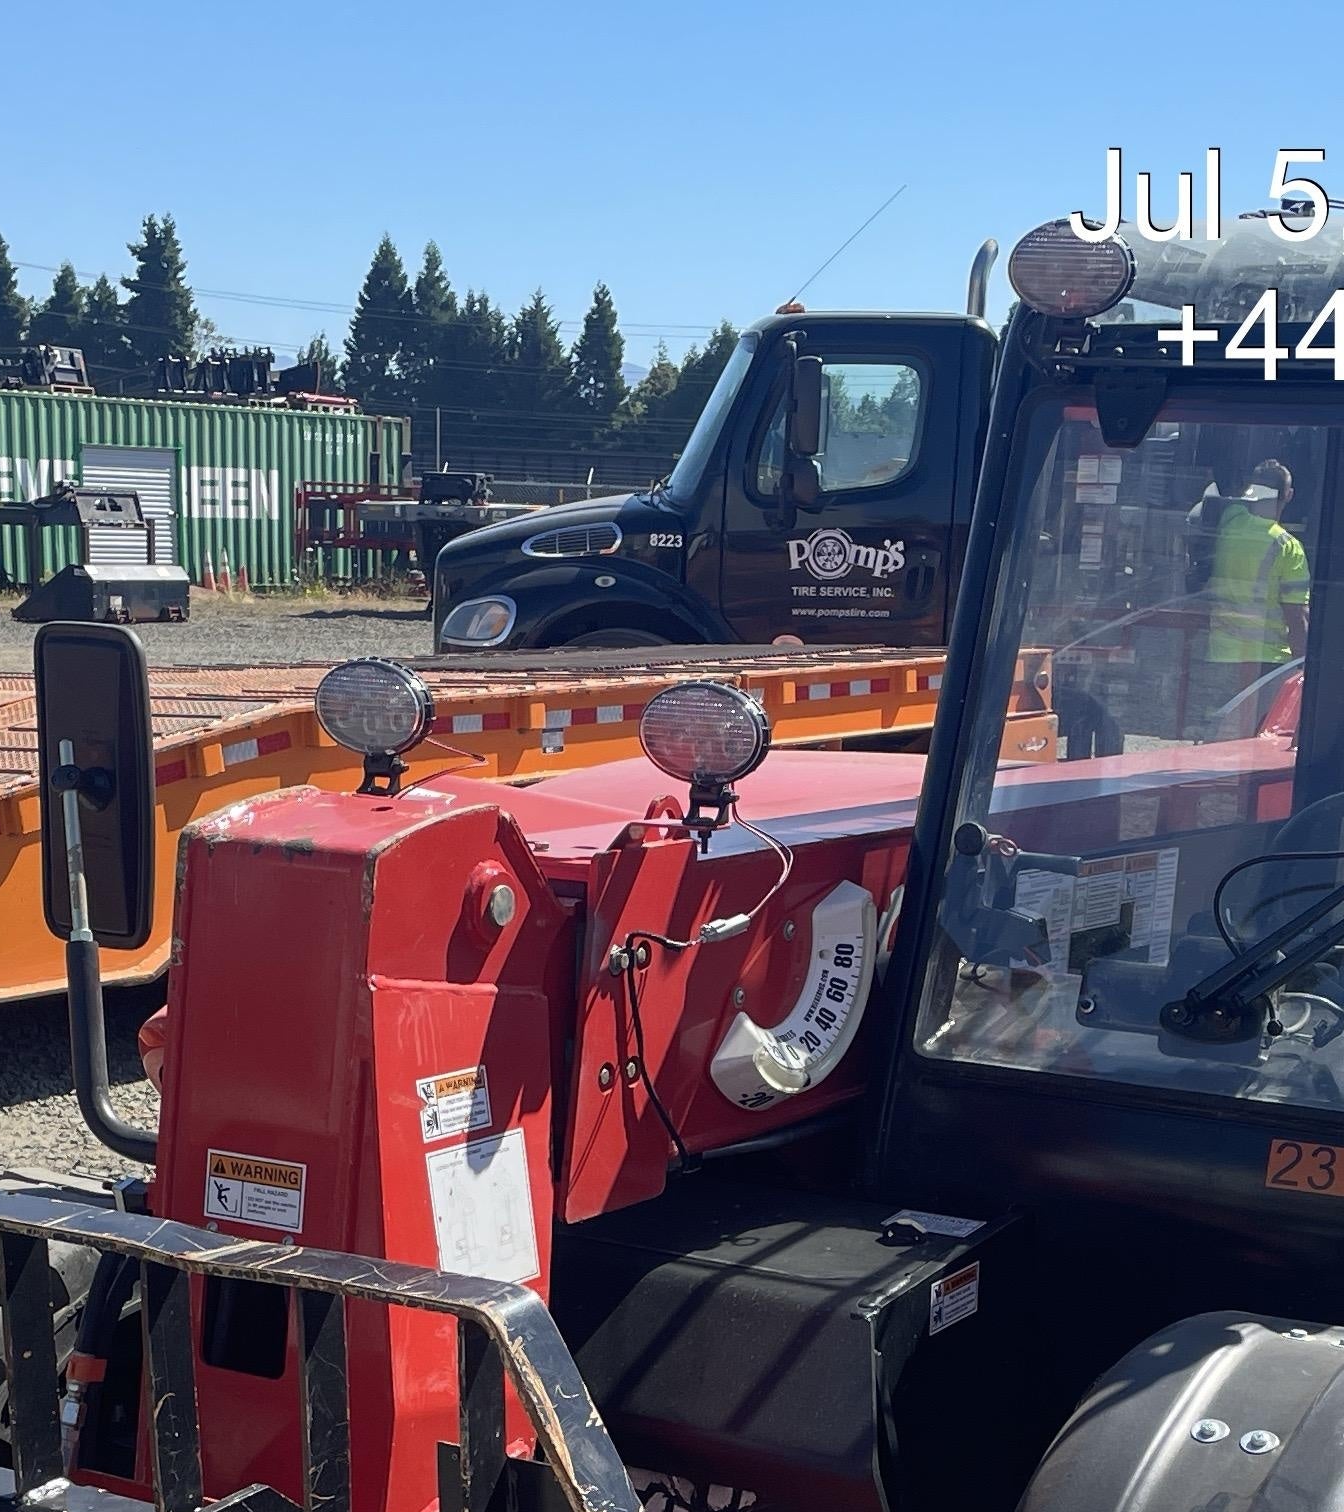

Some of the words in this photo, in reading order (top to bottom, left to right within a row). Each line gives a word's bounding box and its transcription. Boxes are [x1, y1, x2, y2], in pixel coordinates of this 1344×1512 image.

[649, 533, 683, 548] 8223
[791, 586, 818, 597] TIRE
[819, 587, 871, 599] SERVICE,
[872, 587, 895, 598] INC.
[791, 607, 890, 619] www.pompstire.com
[834, 943, 855, 969] 80
[826, 977, 848, 1003] 60
[815, 1007, 837, 1032] 40
[799, 1030, 821, 1054] 20
[230, 1160, 299, 1185] WARNING
